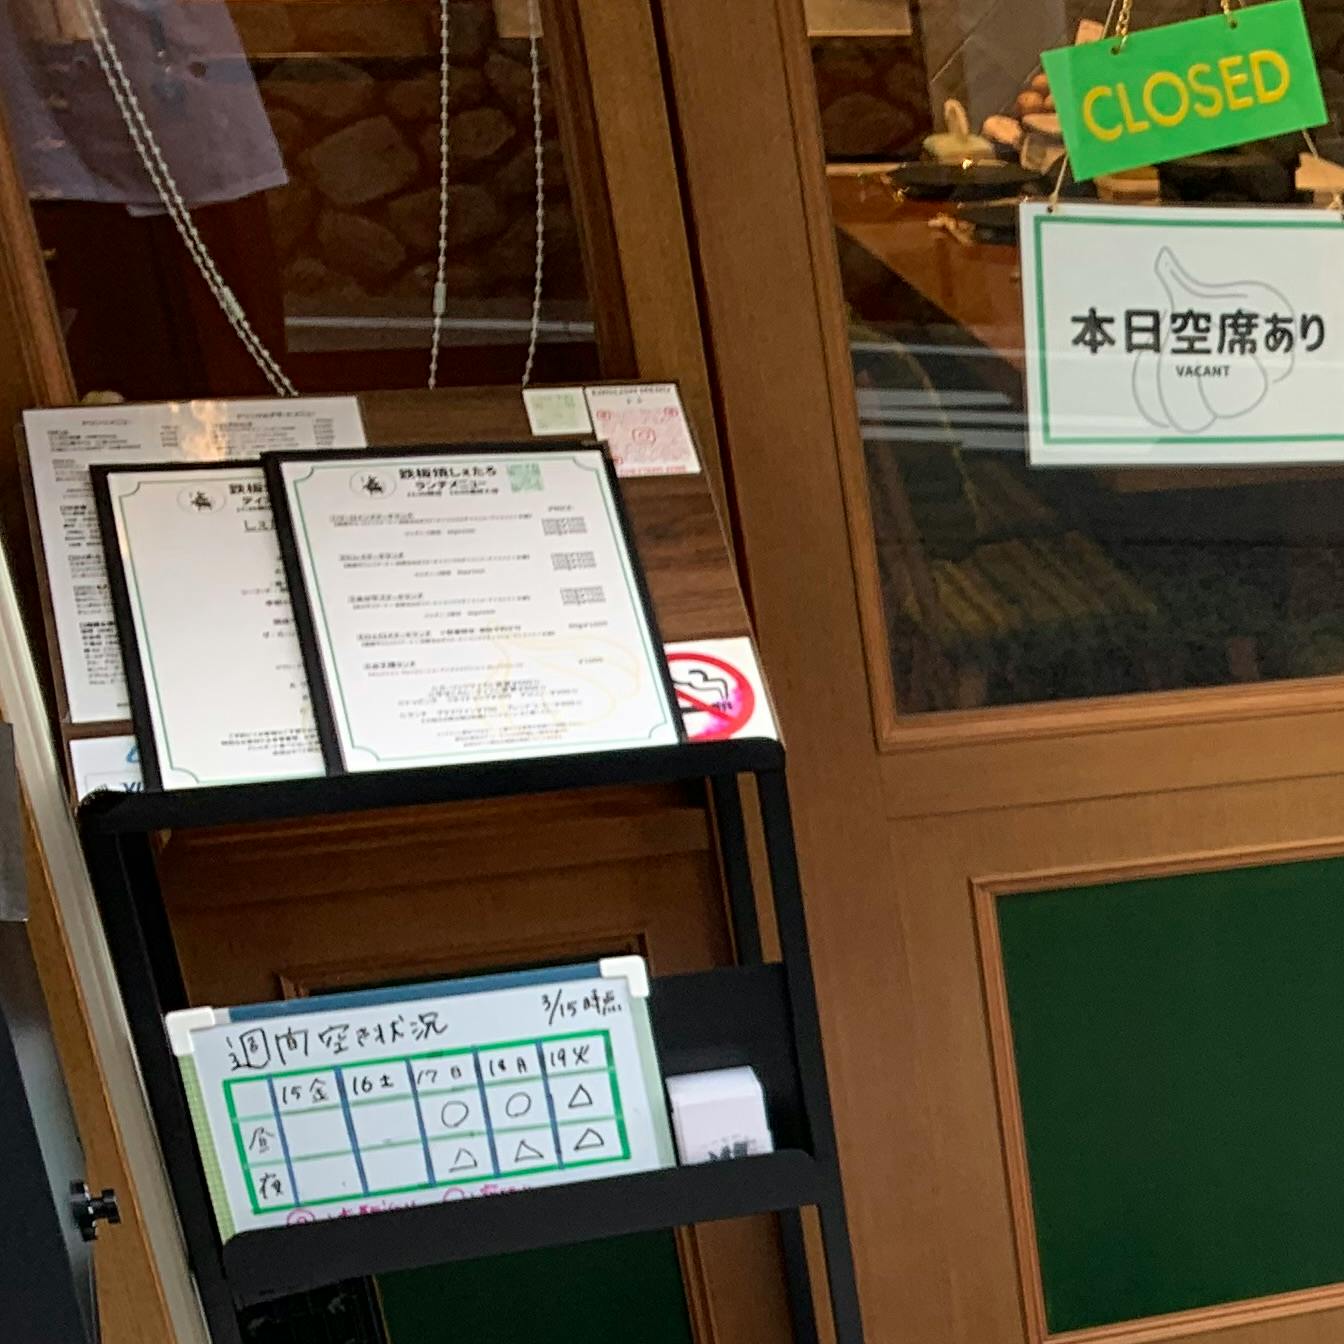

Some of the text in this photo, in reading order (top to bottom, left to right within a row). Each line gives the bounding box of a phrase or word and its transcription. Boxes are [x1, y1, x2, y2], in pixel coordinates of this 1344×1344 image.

[1082, 49, 1291, 142] CLOSED
[1070, 306, 1326, 355] 本日空席あり
[1175, 364, 1231, 378] VACANT
[225, 1011, 449, 1072] 週間空き状況
